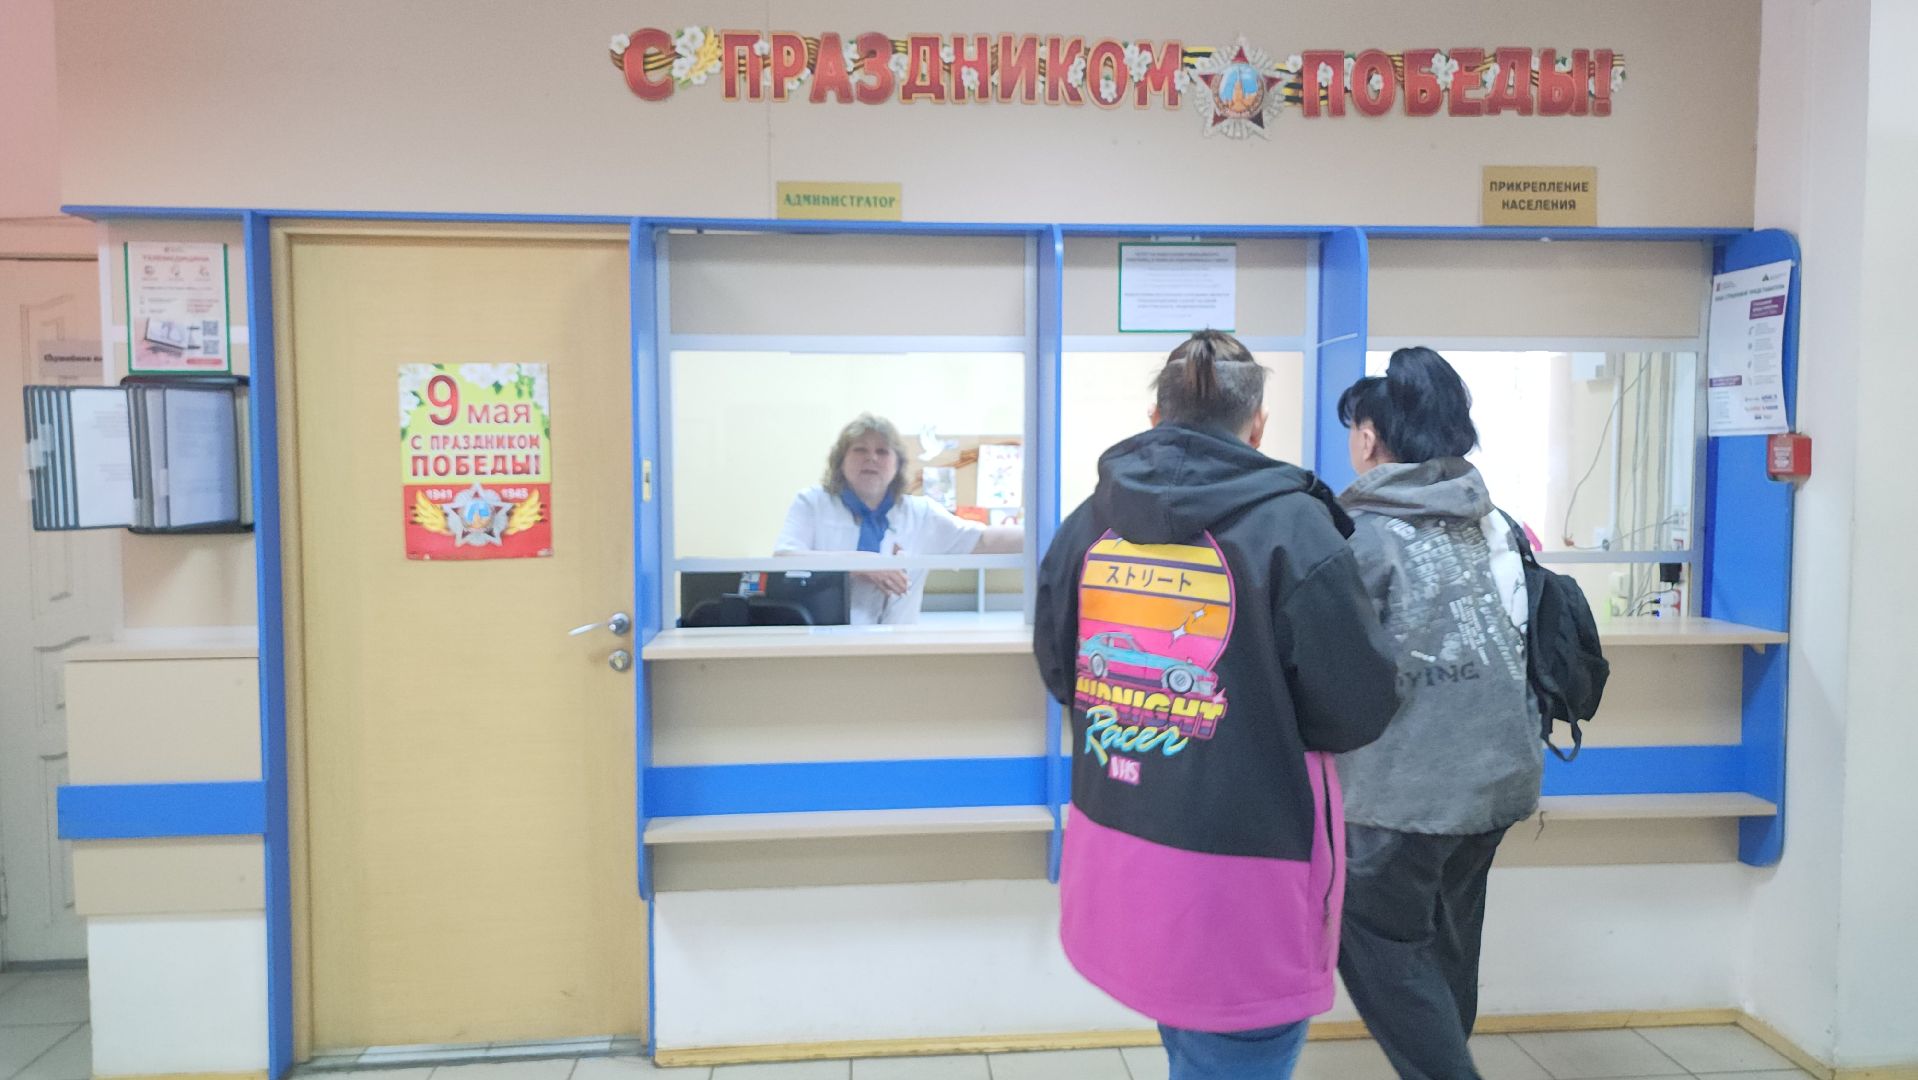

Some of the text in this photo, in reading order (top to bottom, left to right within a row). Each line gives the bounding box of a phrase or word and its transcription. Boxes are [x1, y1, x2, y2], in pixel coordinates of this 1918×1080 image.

[622, 27, 1614, 118] С ПРАЗДНИКОМ ПОБЕДЫ!
[1489, 181, 1589, 193] ПРИКРЕПЛЕНИЕ
[1502, 199, 1577, 211] НАСЕЛЕНИЯ
[427, 375, 531, 426] 9 мая
[411, 434, 540, 450] С ПРАЗДНИКОМ
[412, 455, 540, 477] ПОБЕДЫ!
[1106, 566, 1192, 592] ストリート
[1084, 704, 1190, 767] Racer
[1110, 755, 1141, 784] VHS
